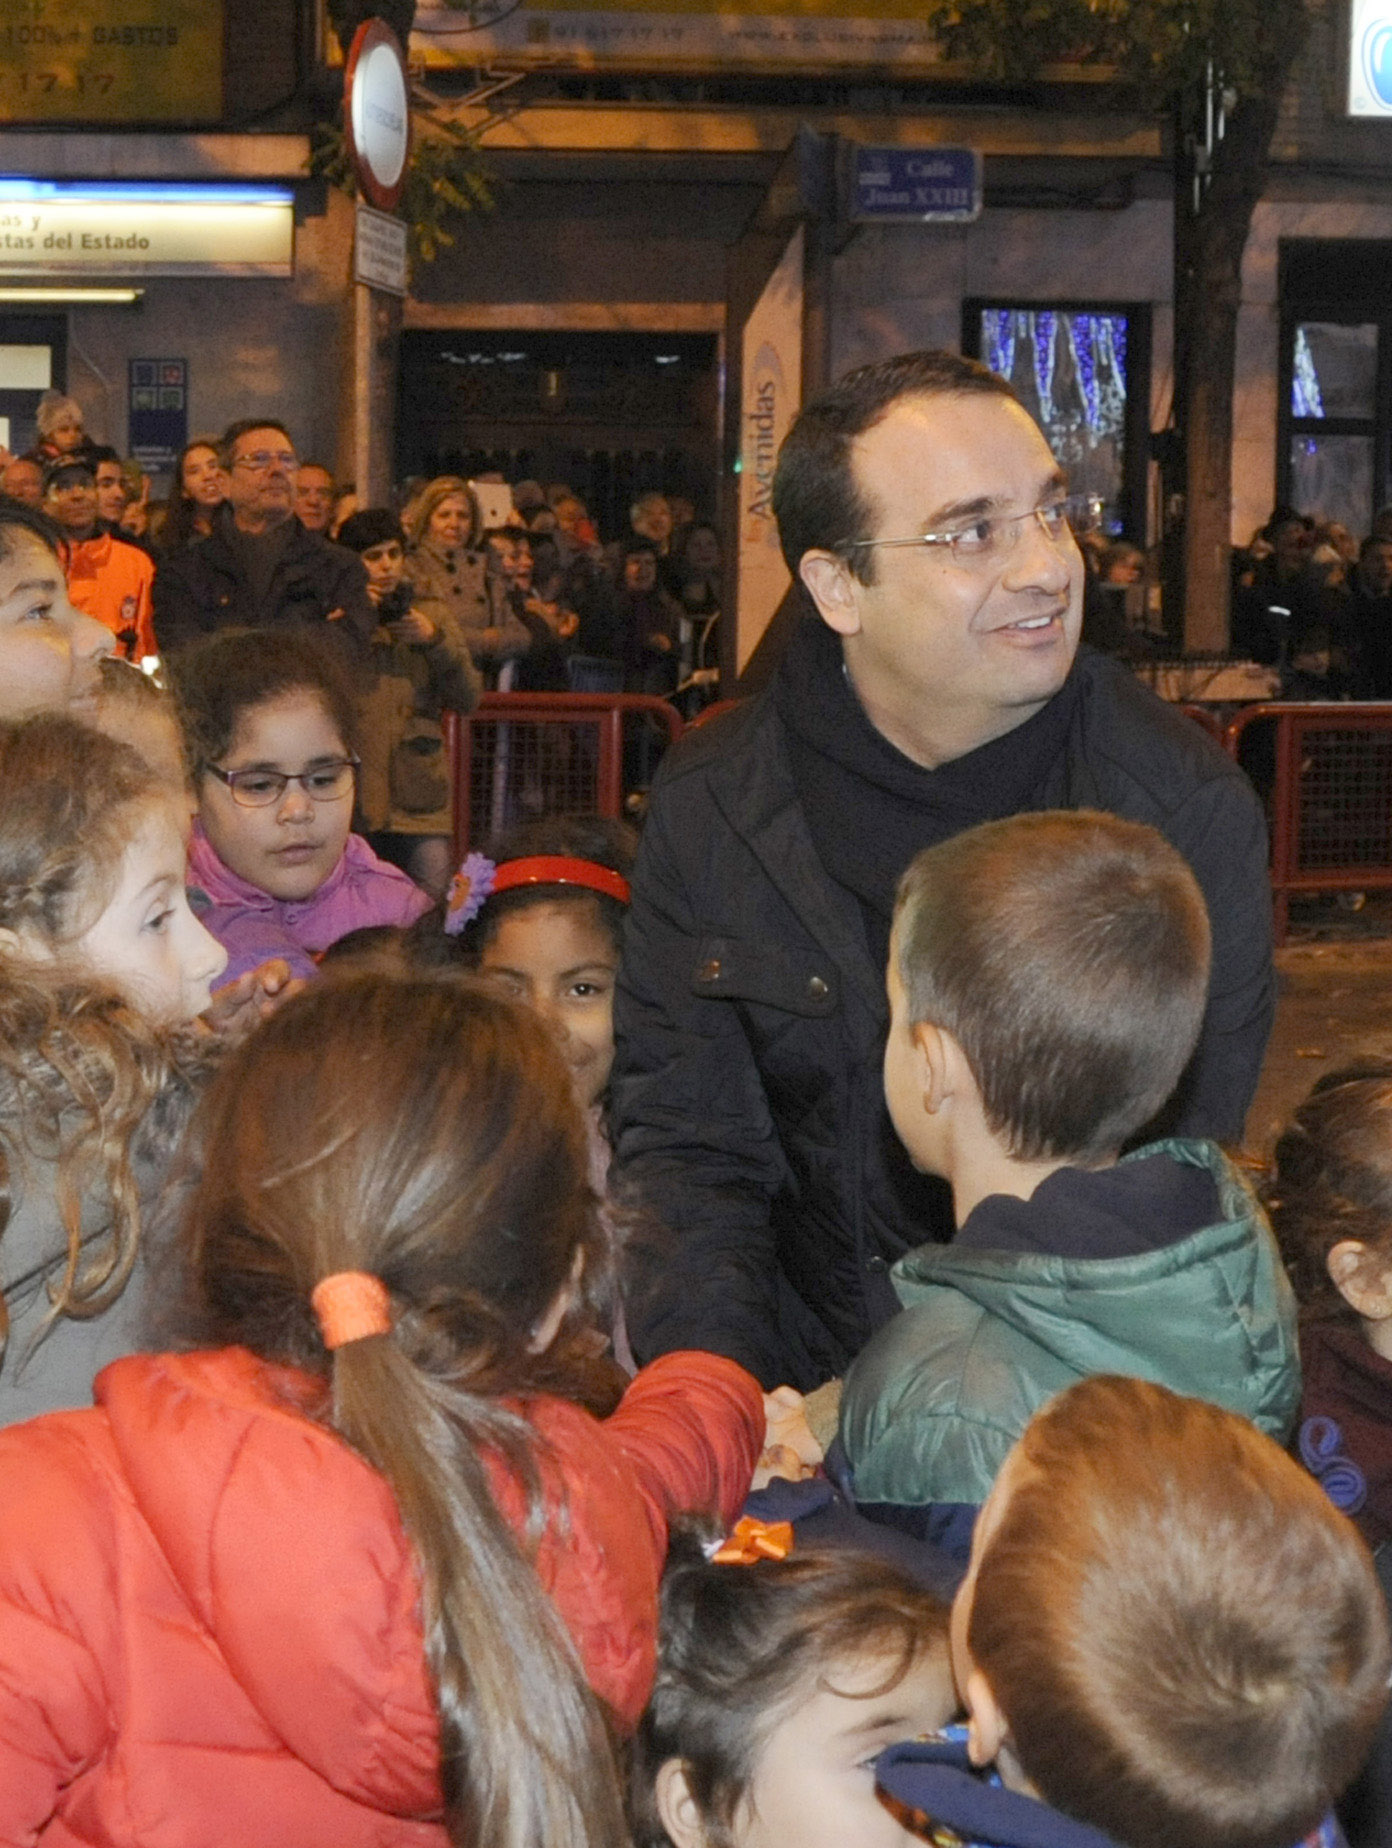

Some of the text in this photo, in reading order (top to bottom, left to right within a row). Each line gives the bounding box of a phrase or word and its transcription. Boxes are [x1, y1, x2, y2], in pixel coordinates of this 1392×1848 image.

[92, 26, 179, 46] GASTOS
[907, 159, 954, 178] Calle
[865, 188, 911, 206] Juan
[31, 214, 41, 231] y
[43, 233, 73, 250] del
[80, 233, 150, 250] Estado
[747, 381, 776, 520] Avenidas
